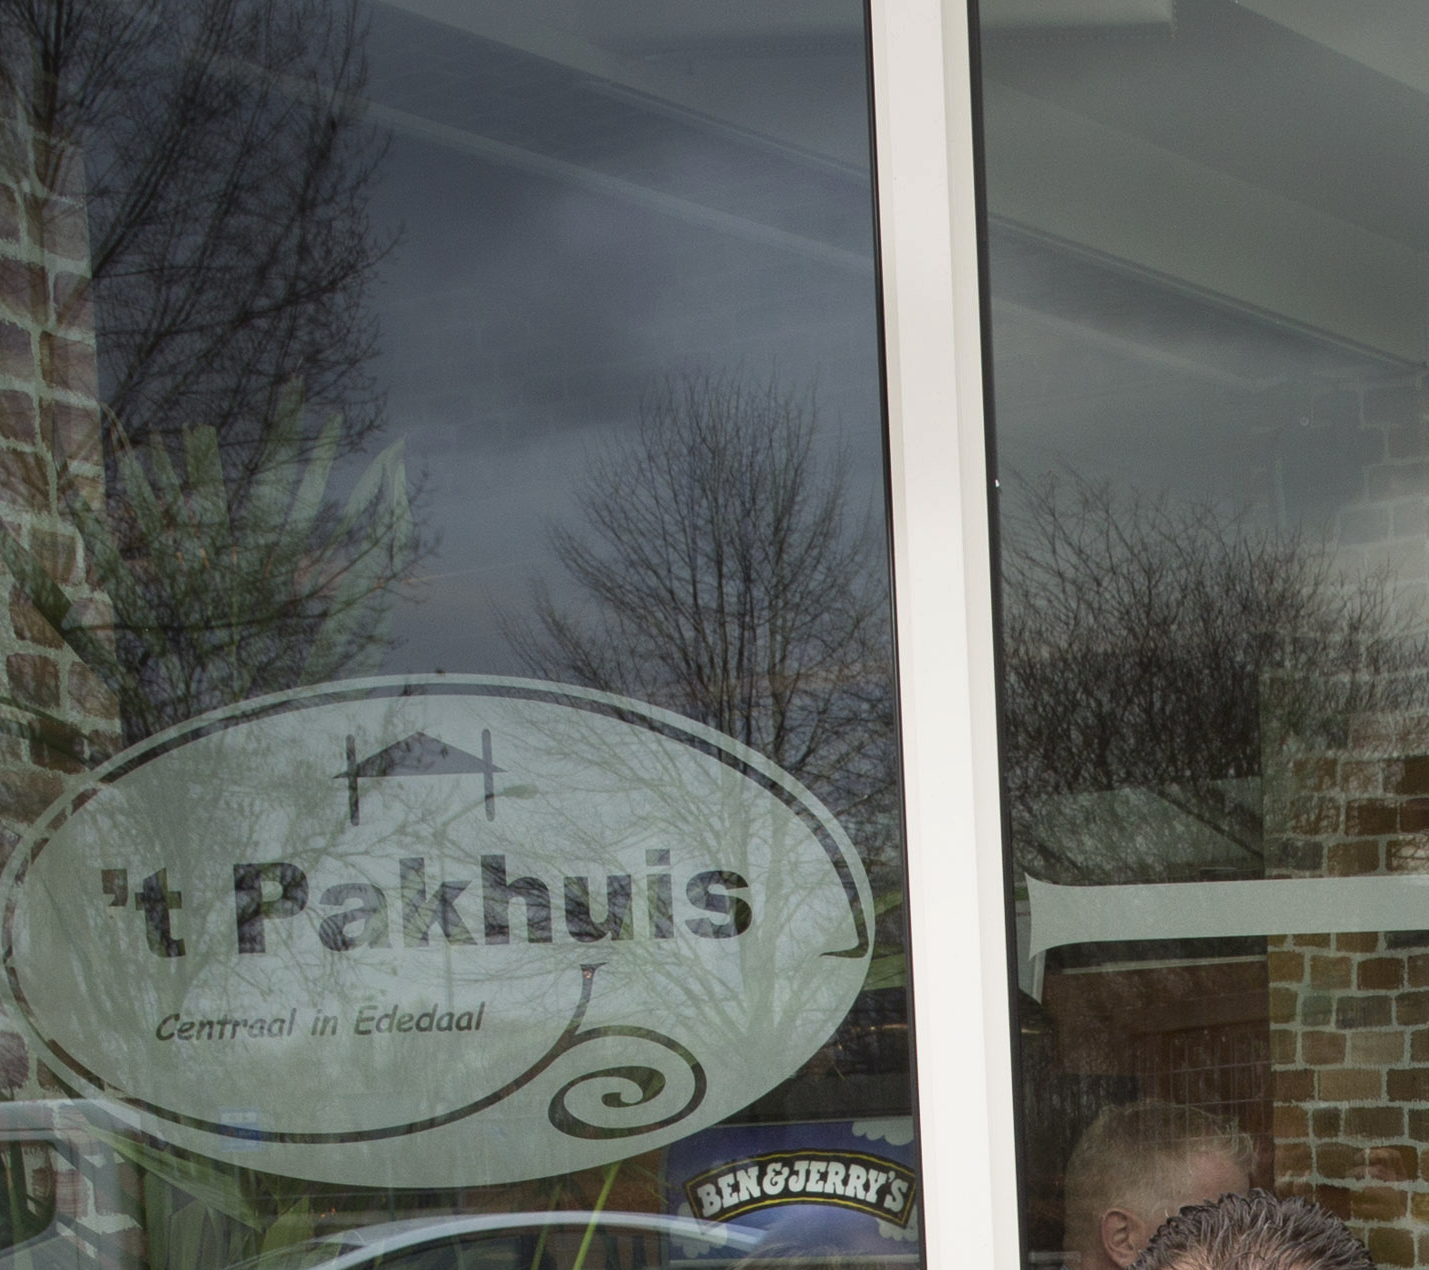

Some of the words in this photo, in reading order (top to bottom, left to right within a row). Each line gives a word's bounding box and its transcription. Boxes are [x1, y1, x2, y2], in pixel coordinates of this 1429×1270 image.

[100, 868, 185, 959] 't
[235, 849, 754, 955] Pakhuis
[155, 1008, 298, 1043] Centraal
[312, 1006, 339, 1037] in
[353, 1001, 484, 1036] Ededaal
